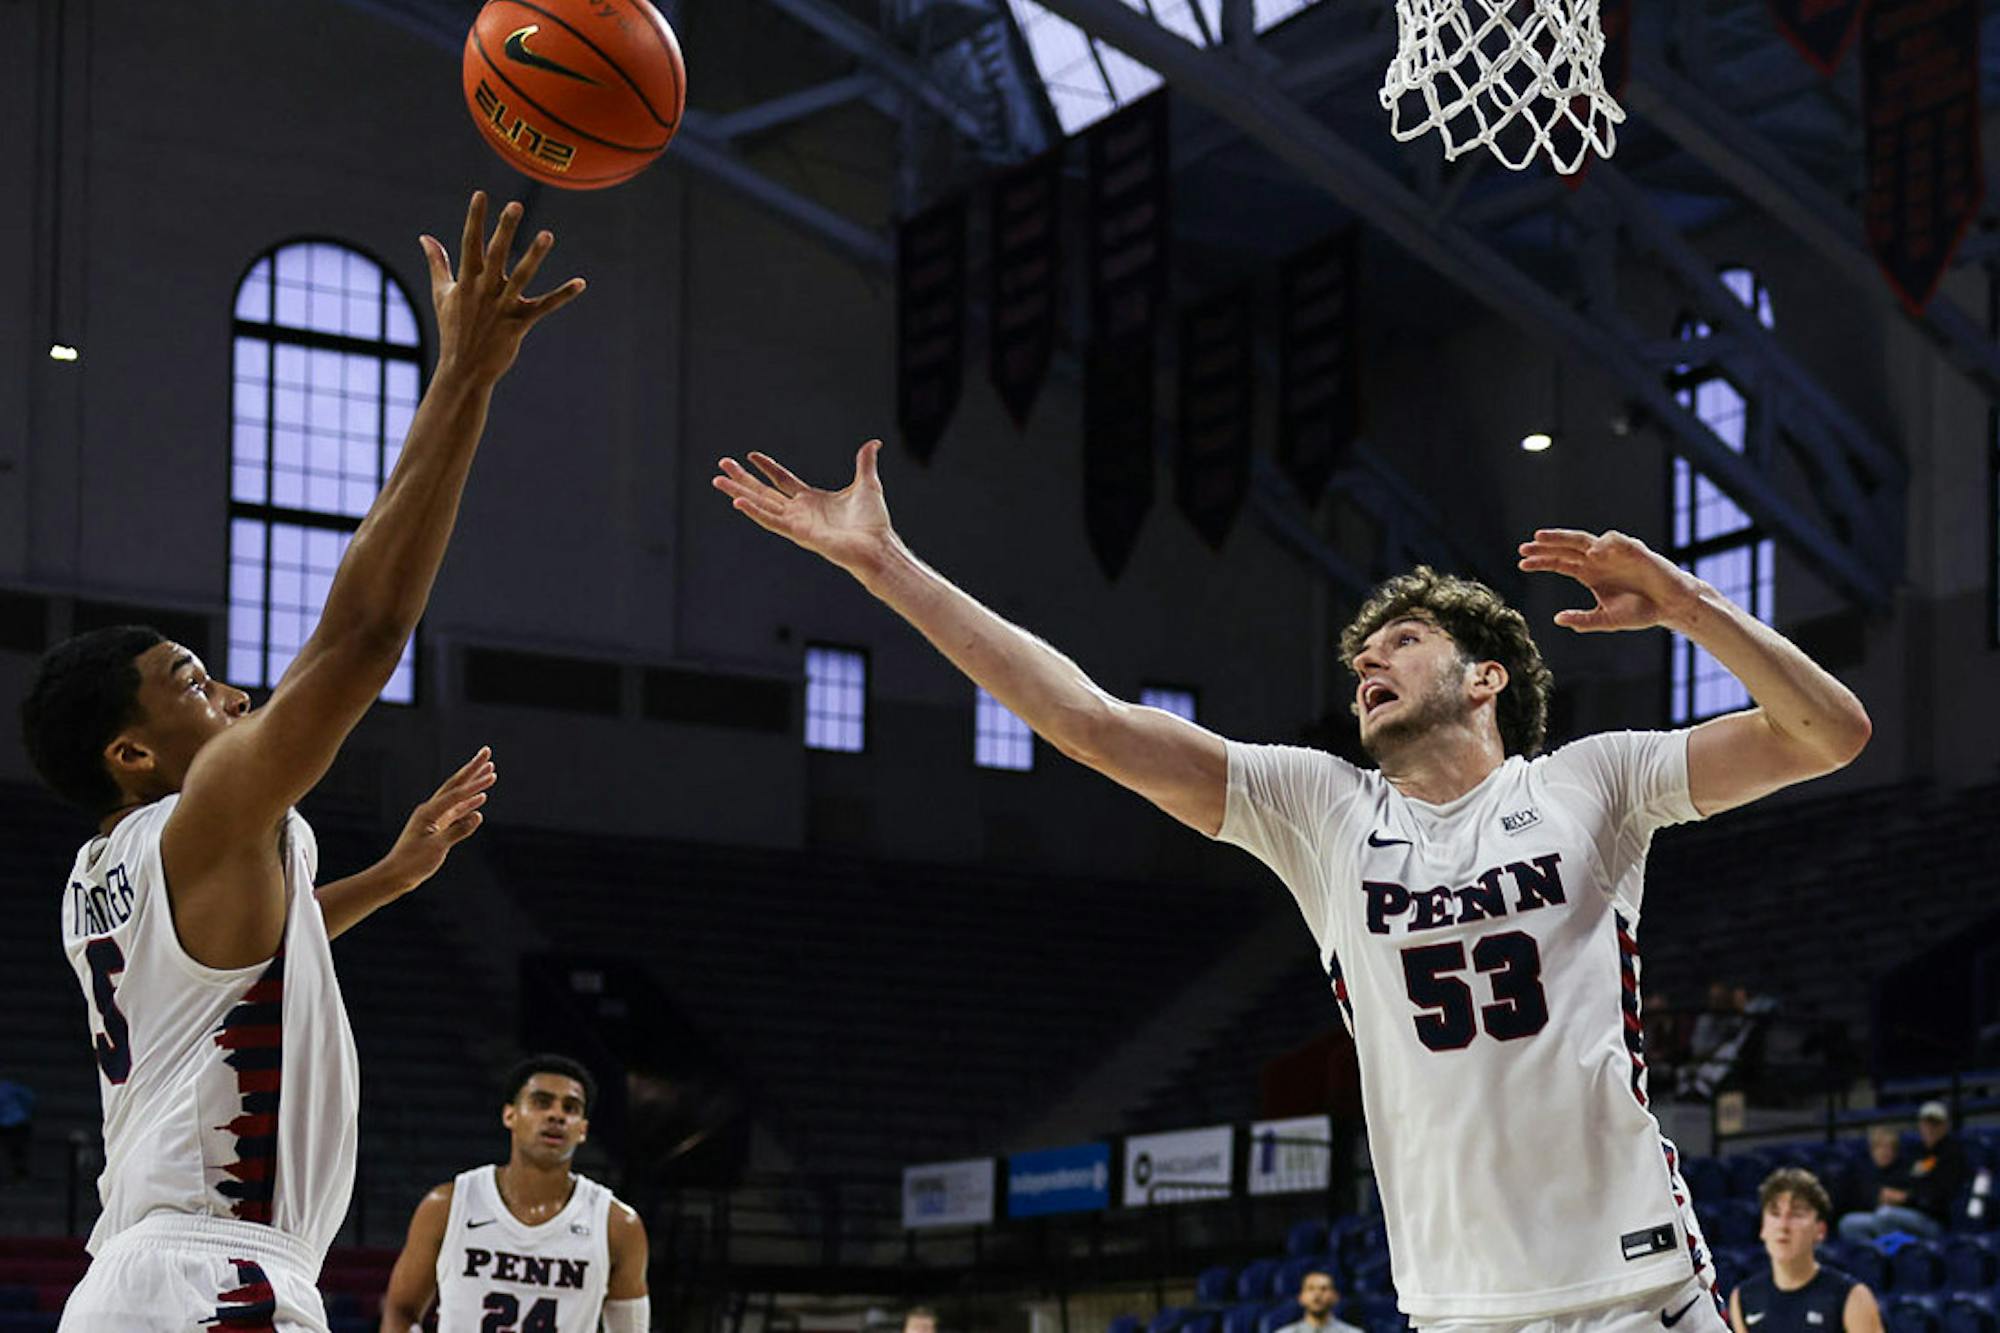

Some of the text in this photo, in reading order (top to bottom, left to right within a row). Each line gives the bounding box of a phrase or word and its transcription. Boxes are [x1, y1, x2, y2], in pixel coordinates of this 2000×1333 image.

[475, 79, 577, 172] ELITE
[1362, 853, 1566, 934] PENN
[86, 936, 132, 1084] 5
[1400, 931, 1549, 1052] 53
[463, 1248, 589, 1290] PENN
[482, 1291, 557, 1333] 24
